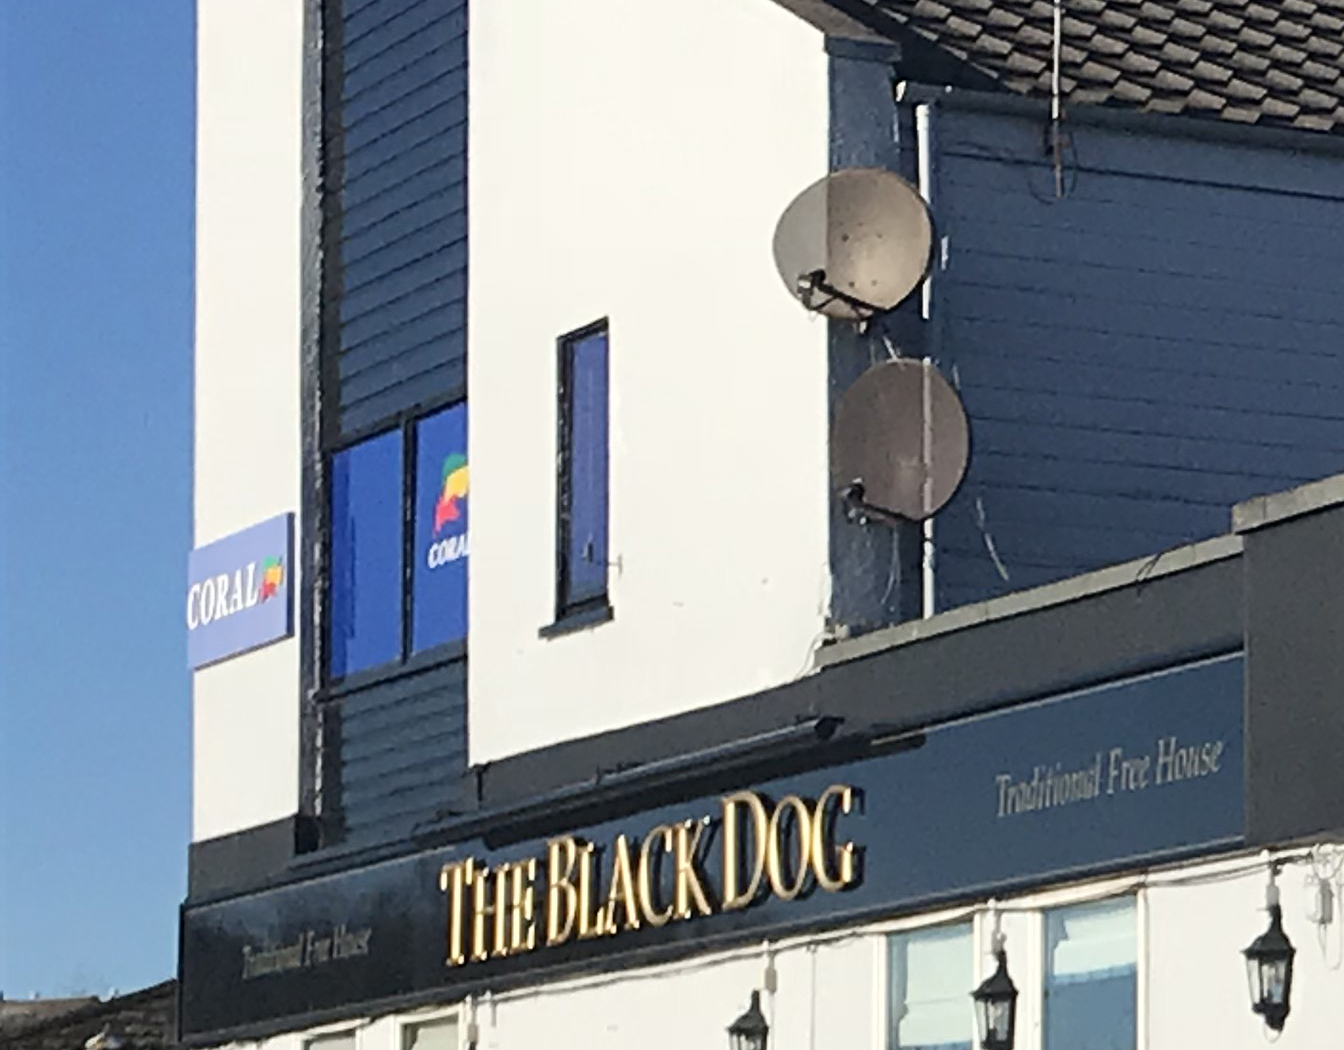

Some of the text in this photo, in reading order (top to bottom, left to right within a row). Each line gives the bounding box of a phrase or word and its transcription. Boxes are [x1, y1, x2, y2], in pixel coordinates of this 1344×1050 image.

[186, 561, 260, 631] CORAL
[995, 736, 1225, 818] Traditional Free House
[440, 857, 536, 966] THE
[547, 815, 712, 947] BLACK
[722, 784, 855, 910] DOG
